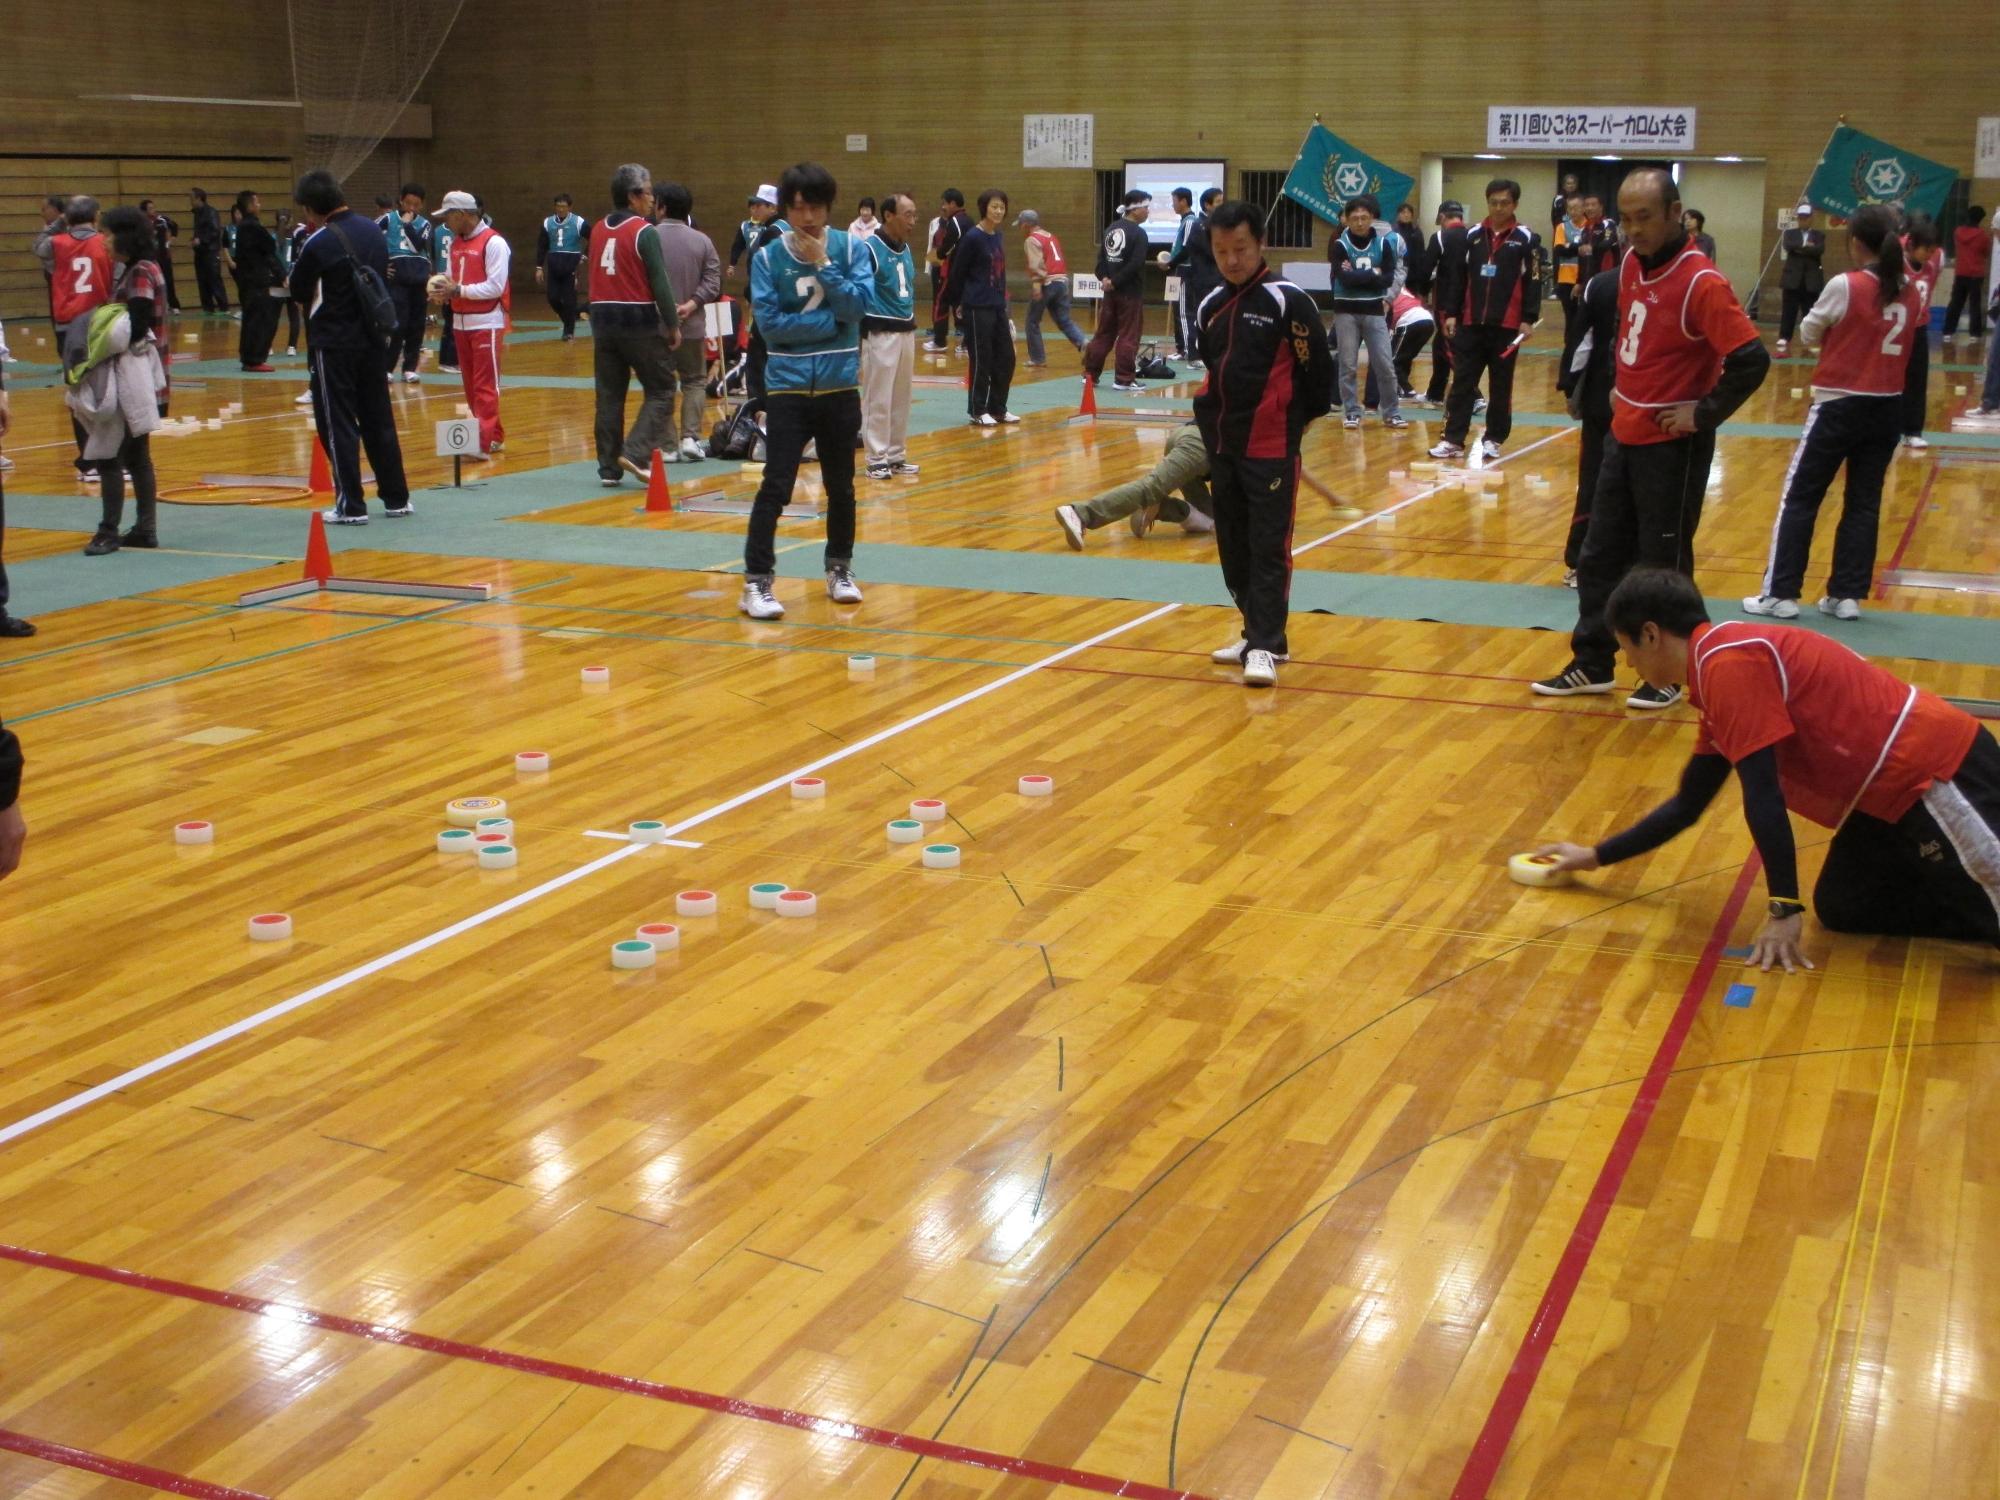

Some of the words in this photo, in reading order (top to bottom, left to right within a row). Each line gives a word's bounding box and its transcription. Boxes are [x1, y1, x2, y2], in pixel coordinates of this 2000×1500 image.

[1500, 113, 1687, 136] 第11回ひこねスーパーカロム大会
[601, 238, 617, 275] 4
[1050, 241, 1061, 261] 1
[72, 257, 92, 293] 2
[896, 262, 909, 298] 1
[796, 276, 824, 314] 2
[1620, 300, 1647, 366] 3
[1881, 302, 1907, 356] 2
